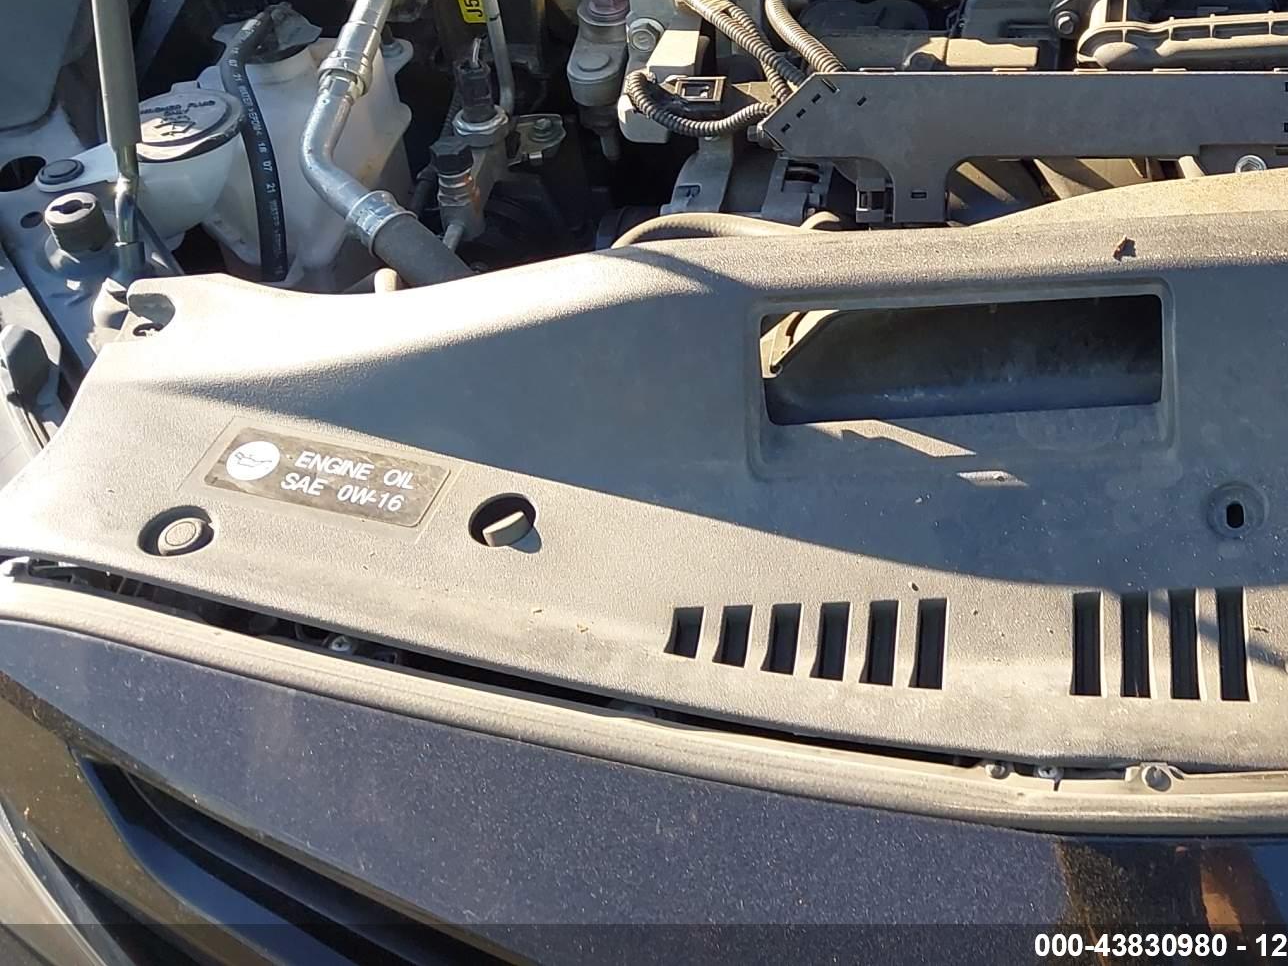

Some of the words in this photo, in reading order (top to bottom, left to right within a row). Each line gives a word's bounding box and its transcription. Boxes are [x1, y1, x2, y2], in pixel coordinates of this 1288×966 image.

[262, 161, 273, 172] 07
[265, 182, 277, 194] 21
[294, 450, 376, 482] ENGINE
[382, 468, 415, 490] OIL
[280, 472, 325, 497] SAE
[336, 484, 404, 511] 0W-16
